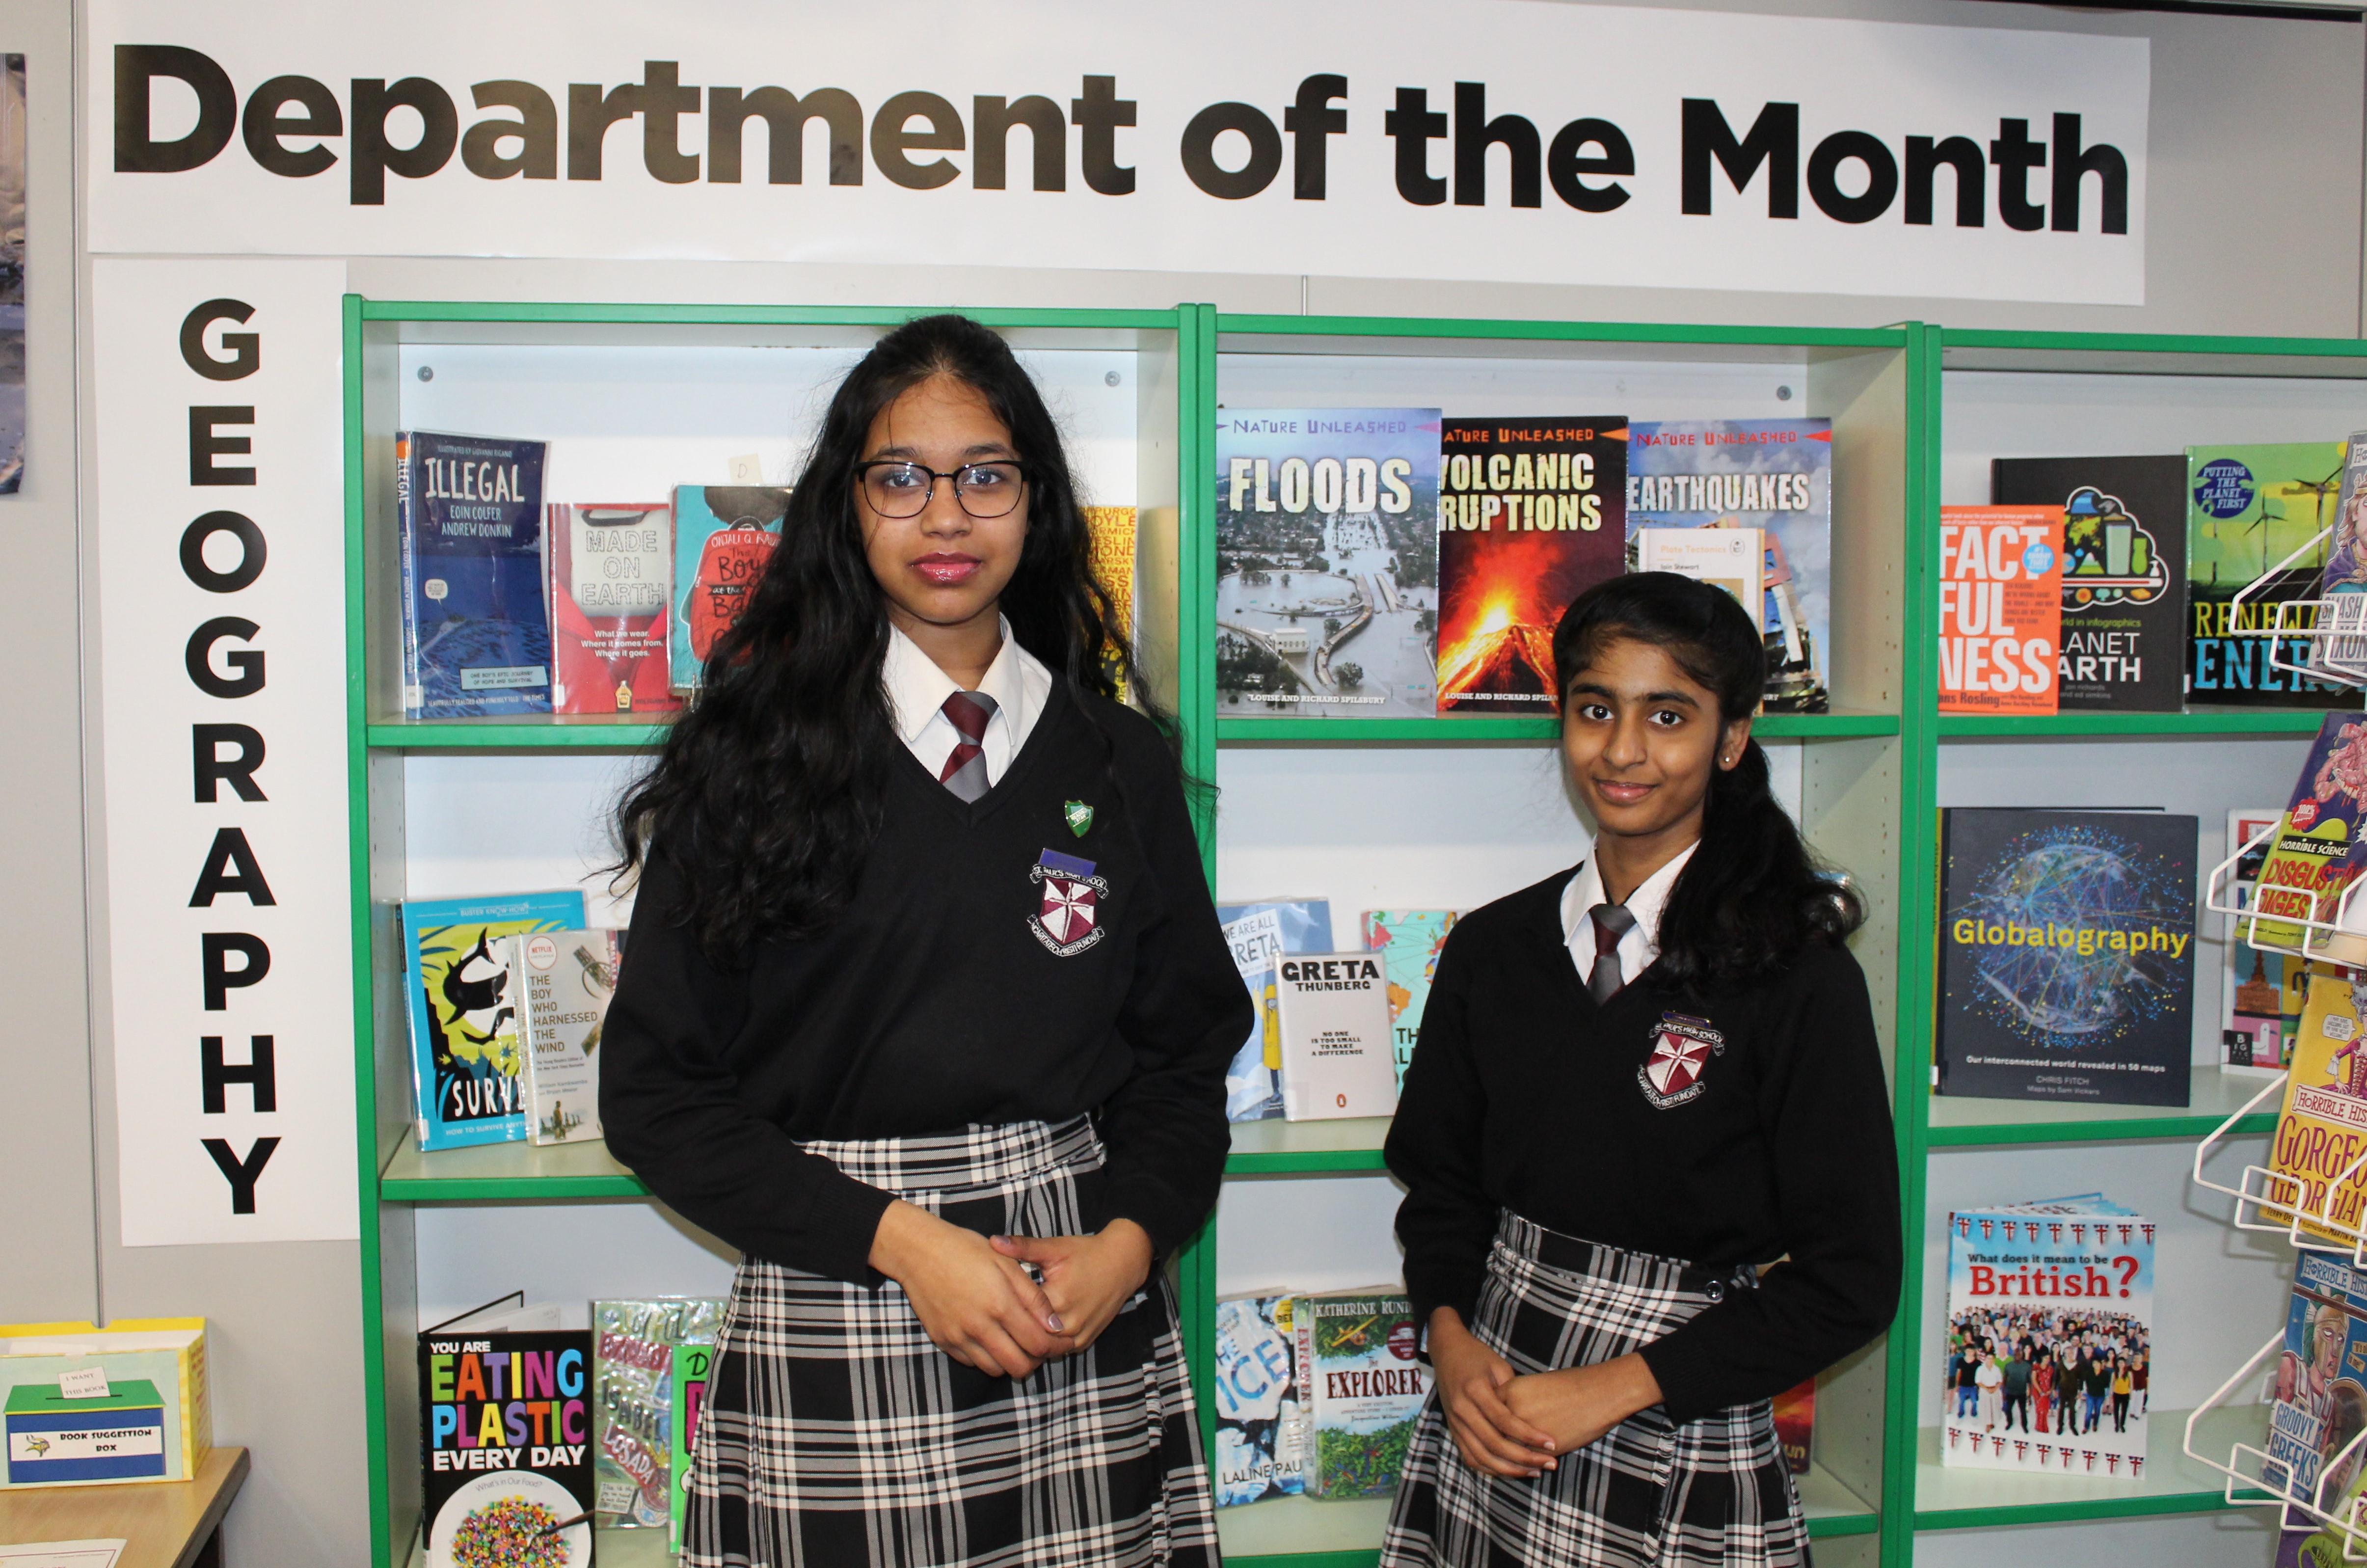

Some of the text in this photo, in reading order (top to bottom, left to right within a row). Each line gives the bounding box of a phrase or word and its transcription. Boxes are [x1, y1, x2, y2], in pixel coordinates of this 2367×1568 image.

[114, 45, 2127, 235] Department of the Month
[1234, 420, 1406, 433] NATURE UNLEASHED
[1445, 429, 1593, 442] ATURE UNLEASHED
[1637, 432, 1797, 446] NATURE UNLEASHED
[425, 457, 525, 503] ILLEGAL
[2203, 466, 2246, 477] PUTTING
[1230, 458, 1412, 514] FLOODS
[2217, 477, 2237, 487] THE
[1628, 474, 1809, 514] EARTHQUAKES
[2203, 488, 2242, 499] PLANET
[451, 505, 501, 520] EOIN COLFER
[1440, 494, 1602, 531] RUPTIONS
[2217, 498, 2247, 509] FIRST
[442, 522, 511, 538] ANDREW DONKIN
[744, 534, 752, 543] Q
[586, 530, 657, 552] MADE
[1686, 545, 1726, 553] Tectonics
[1940, 526, 2048, 580] FACT
[603, 557, 640, 579] ON
[581, 583, 664, 606] EARTH
[1940, 582, 2015, 636] FUL
[2086, 618, 2142, 628] infographics
[2058, 631, 2141, 654] ANET
[1938, 638, 2052, 694] NESS
[2057, 656, 2141, 682] ARTH
[1302, 695, 1339, 703] RICHARD
[1341, 696, 1385, 704] SPILSBURY
[1938, 692, 2000, 707] ans Rosling
[180, 299, 281, 1214] GEOGRAPHY
[2279, 839, 2348, 856] HORRIBLE SCIENCE
[1238, 921, 1256, 936] ARE
[1258, 916, 1275, 930] ALL
[1953, 919, 2189, 958] Globalography
[1228, 932, 1280, 965] RETA
[1281, 960, 1380, 981] GRETA
[530, 975, 550, 986] THE
[1295, 981, 1371, 992] THUNBERG
[531, 989, 551, 1000] BOY
[532, 1001, 557, 1013] WHO
[533, 1012, 597, 1026] HARNESSED
[534, 1029, 556, 1040] THE
[535, 1042, 565, 1054] WIND
[1966, 1055, 1982, 1063] Our
[1984, 1056, 2050, 1067] interconnected
[2051, 1060, 2076, 1068] world
[2077, 1062, 2116, 1071] revealed
[2141, 1065, 2166, 1074] maps
[2036, 1076, 2090, 1085] CHRIS FITCH
[2298, 1092, 2345, 1117] HORRIBLE
[476, 1124, 503, 1132] SURVIVE
[1968, 1254, 2108, 1264] What does it mean to be
[2304, 1259, 2348, 1288] HORRIBLE
[1316, 1302, 1376, 1317] KATHERINE
[430, 1341, 490, 1353] YOU ARE
[1216, 1339, 1240, 1366] HE
[431, 1349, 584, 1402] EATING
[1216, 1339, 1290, 1412] ICE
[1327, 1368, 1423, 1399] EXPLORER
[432, 1399, 585, 1449] PLASTIC
[2275, 1403, 2314, 1441] GROOVY
[60, 1429, 152, 1441] BOOK SUGGESTION
[433, 1445, 586, 1471] EVERY DAY
[604, 1417, 655, 1485] LOSADA
[476, 1479, 499, 1491] What's
[522, 1478, 542, 1488] Food?
[1223, 1467, 1270, 1485] LALINE
